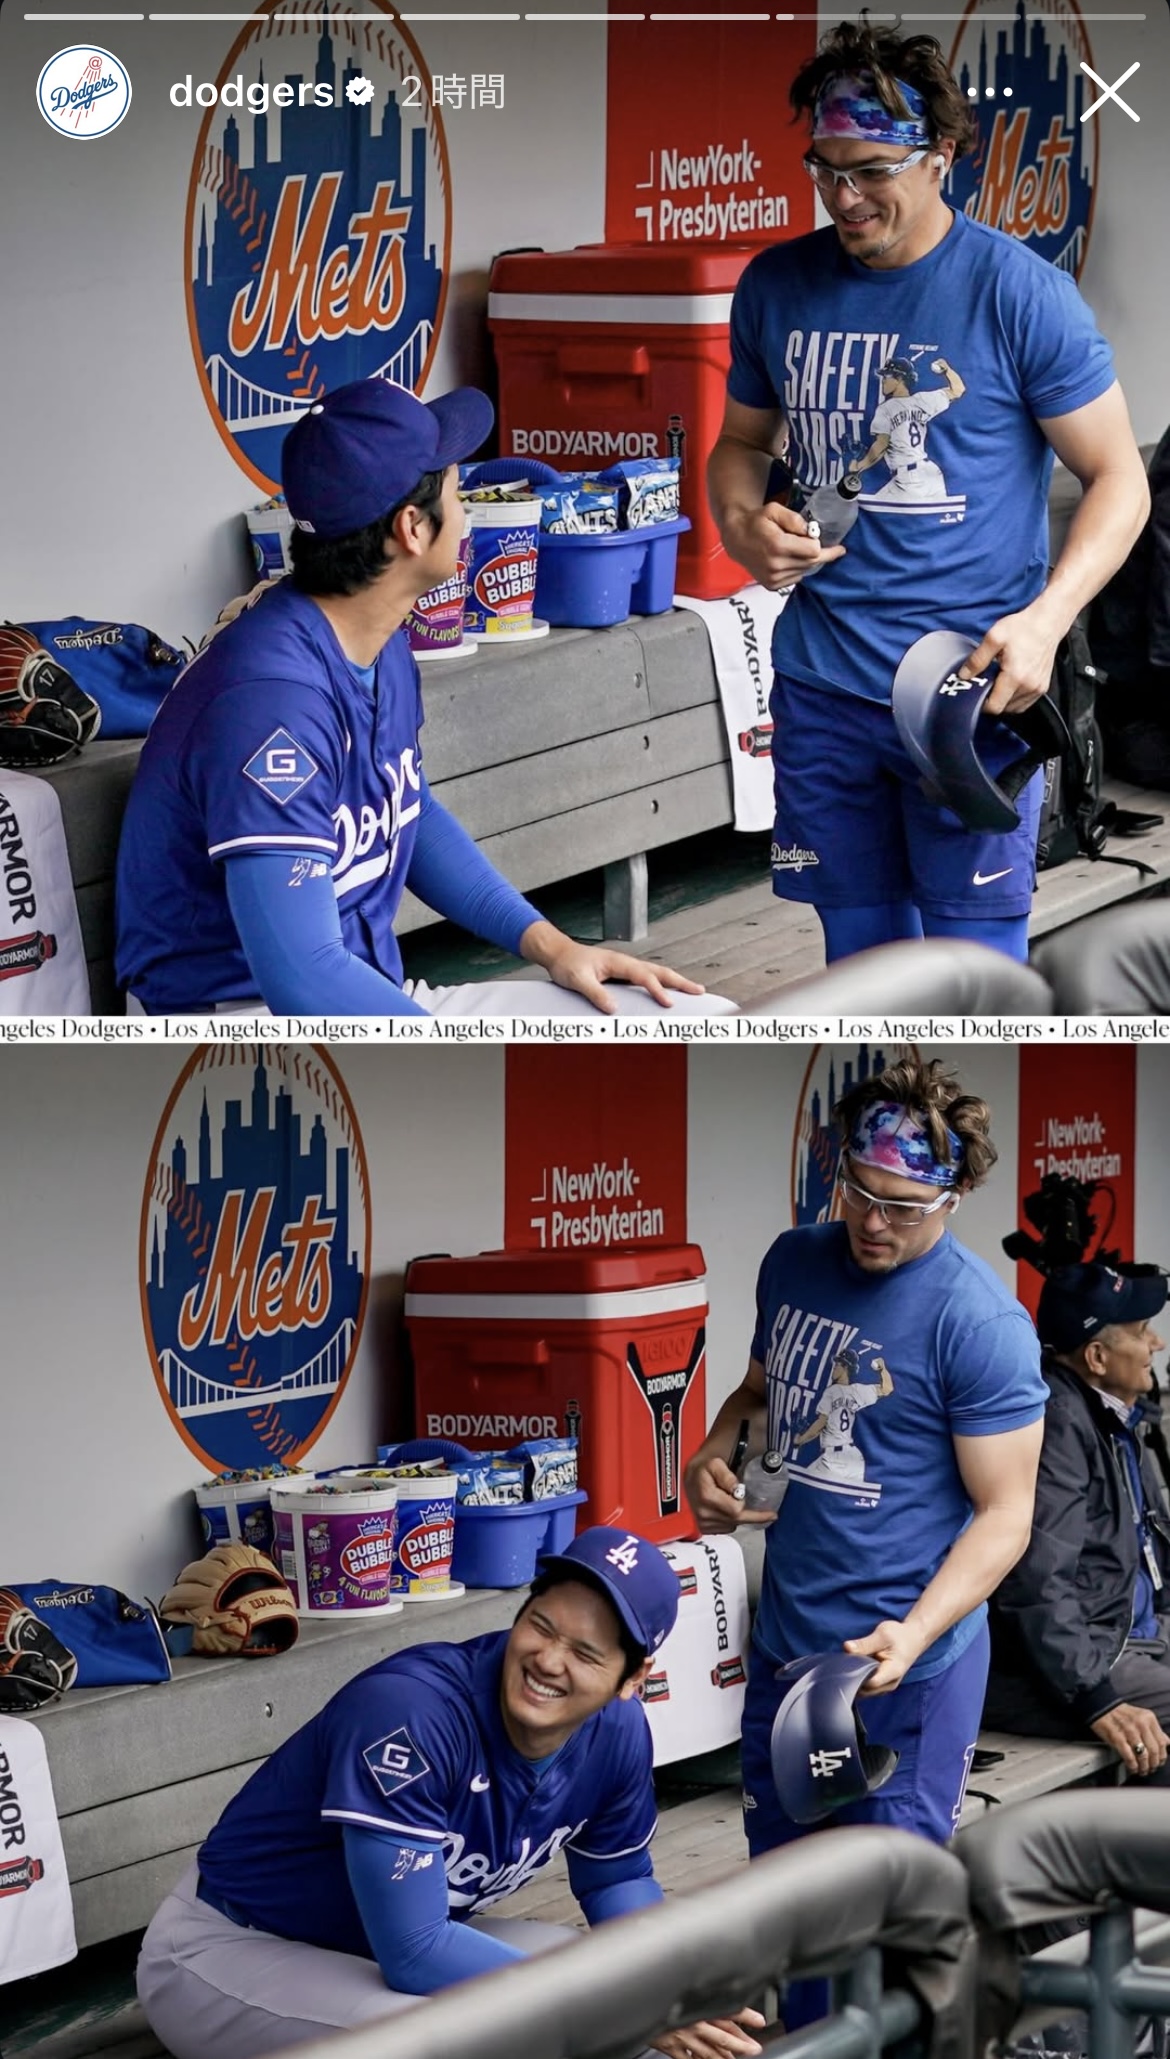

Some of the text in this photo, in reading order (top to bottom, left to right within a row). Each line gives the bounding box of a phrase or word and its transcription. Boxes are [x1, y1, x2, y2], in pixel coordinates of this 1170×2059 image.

[660, 138, 762, 191] NewYork-
[964, 107, 1075, 241] Mets
[659, 186, 789, 241] Presbyterian
[228, 171, 413, 357] Mets
[784, 330, 900, 411] SAFETY
[511, 429, 659, 457] BODYARMOR
[907, 421, 921, 448] 8
[481, 558, 538, 587] DUBBLE
[486, 575, 536, 604] BUBBL
[39, 668, 56, 687] 17
[266, 749, 297, 774] G
[0, 793, 37, 925] ARMOR
[770, 842, 820, 873] Dodgers
[1047, 1112, 1106, 1148] NewYork-
[552, 1157, 640, 1204] NewYork-
[551, 1199, 664, 1248] Presbyterian
[178, 1186, 338, 1351] Mets
[766, 1303, 860, 1391] SAFETY
[646, 1371, 687, 1396] BODYARMOR
[425, 1414, 558, 1438] BODYARMOR
[766, 1377, 815, 1461] IRST
[840, 1408, 850, 1432] 8
[346, 1537, 393, 1561] DUBBLE
[410, 1541, 453, 1568] BUBBL
[605, 1535, 640, 1576] LA
[23, 1624, 39, 1641] 17
[382, 1743, 412, 1770] G
[809, 1746, 852, 1778] LA
[0, 1751, 26, 1850] RMOR
